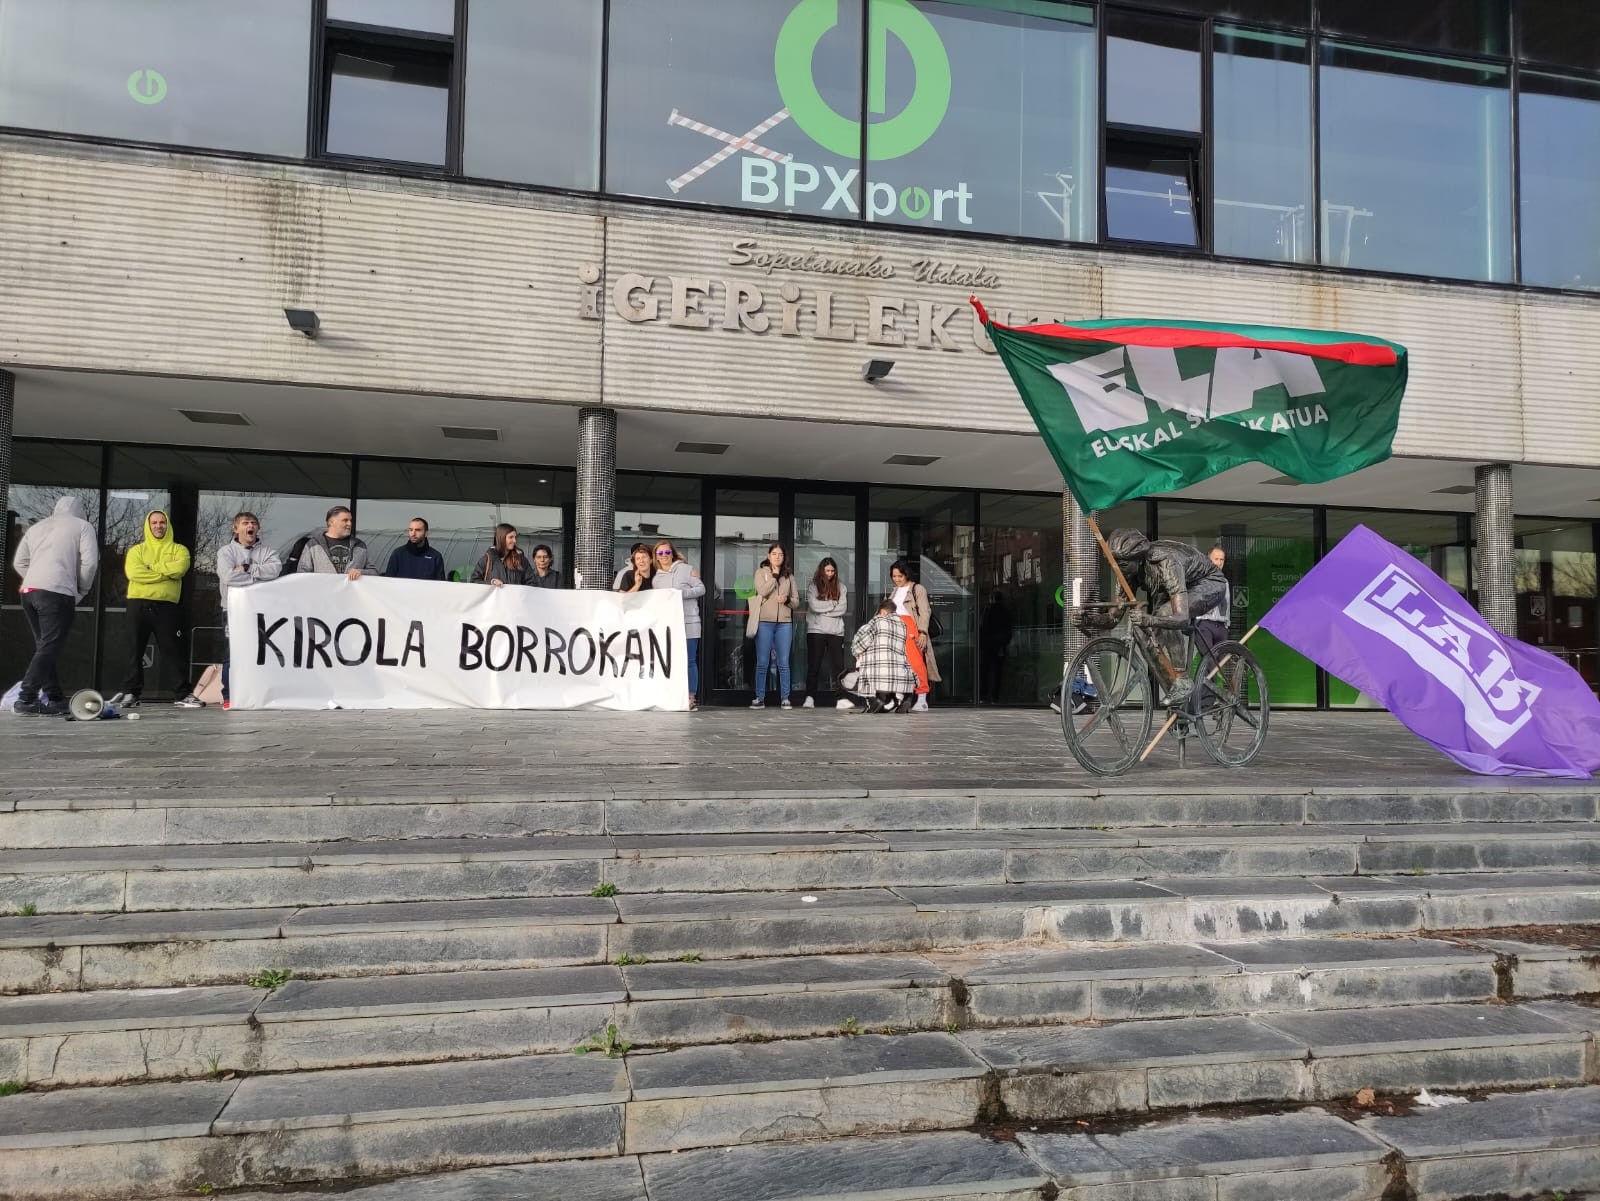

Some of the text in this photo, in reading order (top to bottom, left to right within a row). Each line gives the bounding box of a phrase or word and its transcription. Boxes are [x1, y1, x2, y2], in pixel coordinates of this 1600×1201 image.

[728, 239, 1001, 289] Sopelanako Udala
[1046, 344, 1327, 434] ELA
[1090, 420, 1184, 459] EUSKAL
[256, 613, 671, 679] KIROLA BORROKAN
